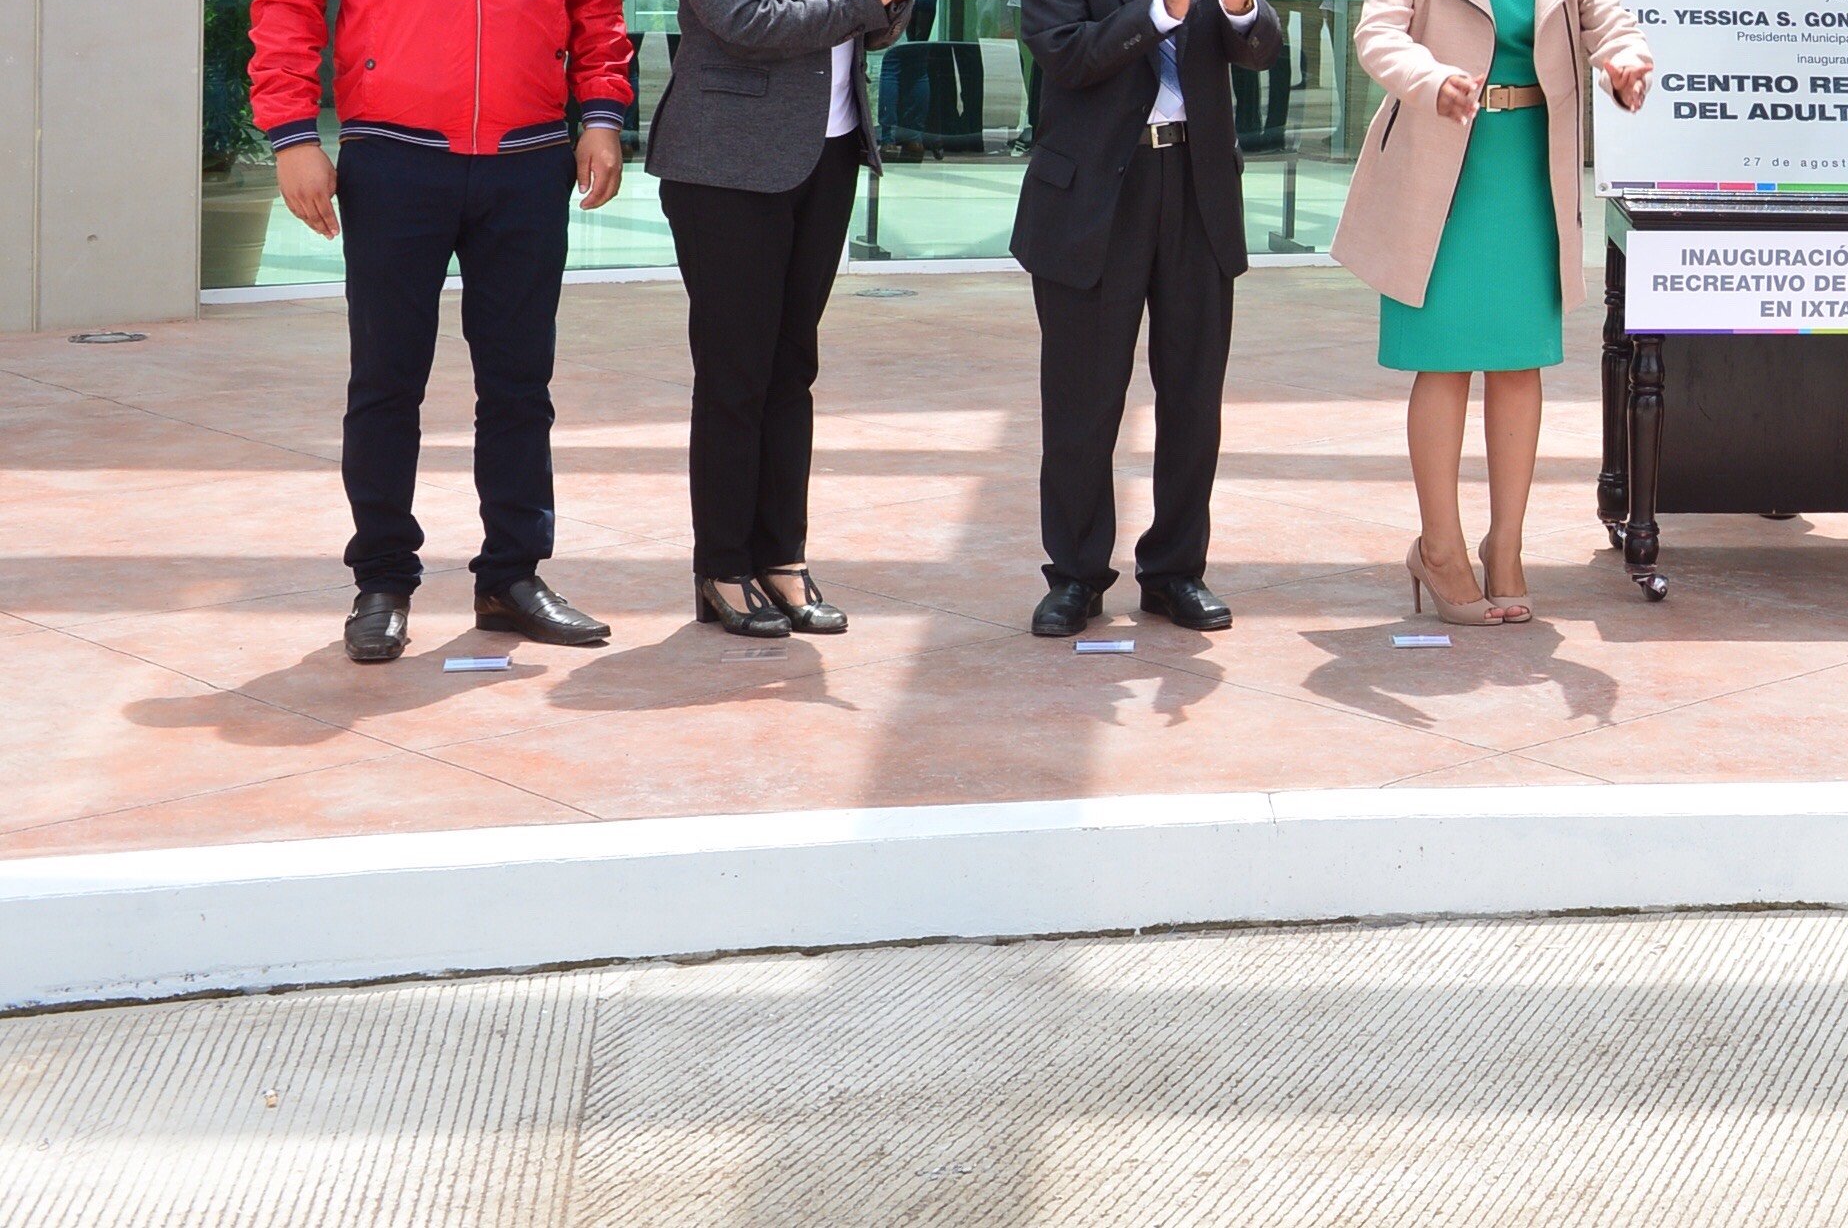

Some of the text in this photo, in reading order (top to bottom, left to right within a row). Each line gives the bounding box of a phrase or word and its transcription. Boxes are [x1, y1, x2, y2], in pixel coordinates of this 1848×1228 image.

[1624, 9, 1667, 24] IC.
[1674, 9, 1770, 26] YESSICA
[1777, 11, 1797, 27] S.
[1737, 31, 1797, 43] Presidenta
[1661, 73, 1799, 93] CENTRO
[1673, 102, 1738, 120] DEL
[1743, 157, 1761, 167] 27
[1772, 158, 1790, 167] de
[1652, 275, 1805, 292] RECREATIVO
[1760, 301, 1792, 318] EN
